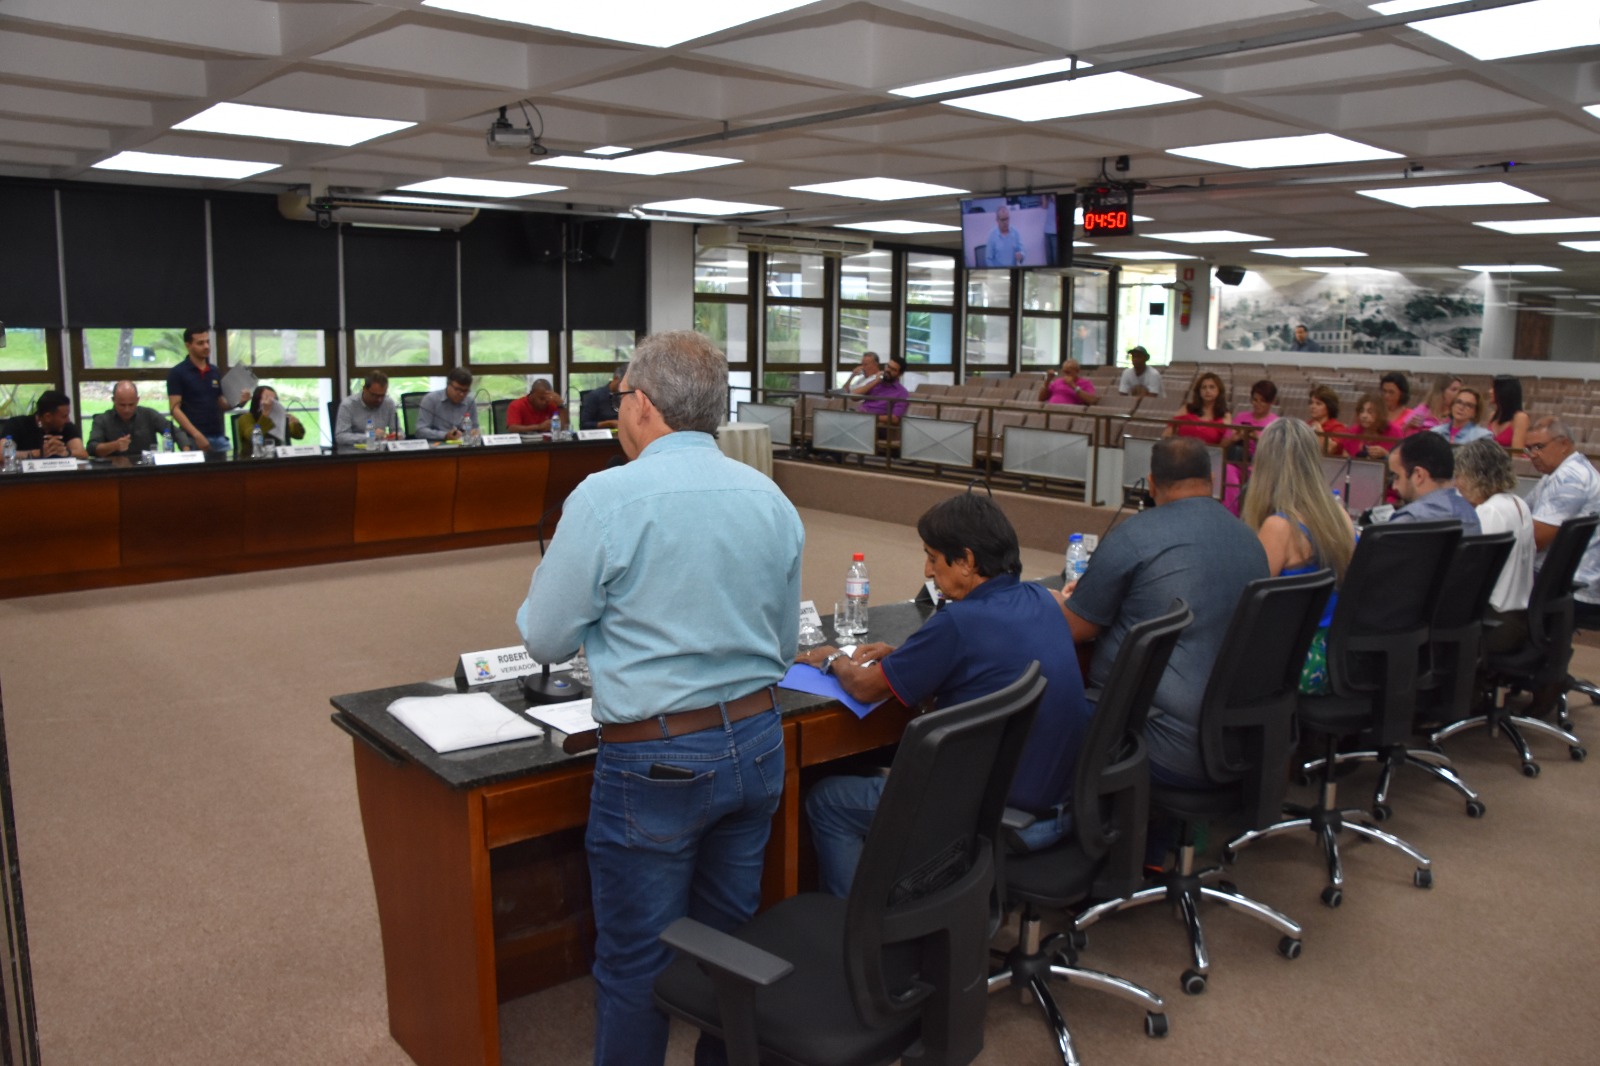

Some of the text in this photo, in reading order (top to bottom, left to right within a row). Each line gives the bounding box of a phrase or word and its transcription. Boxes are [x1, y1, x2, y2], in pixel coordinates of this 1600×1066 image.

[1085, 212, 1127, 229] 04:50
[800, 607, 815, 615] ANTOS
[497, 651, 528, 663] ROBERT
[500, 663, 537, 673] VEREADOR
